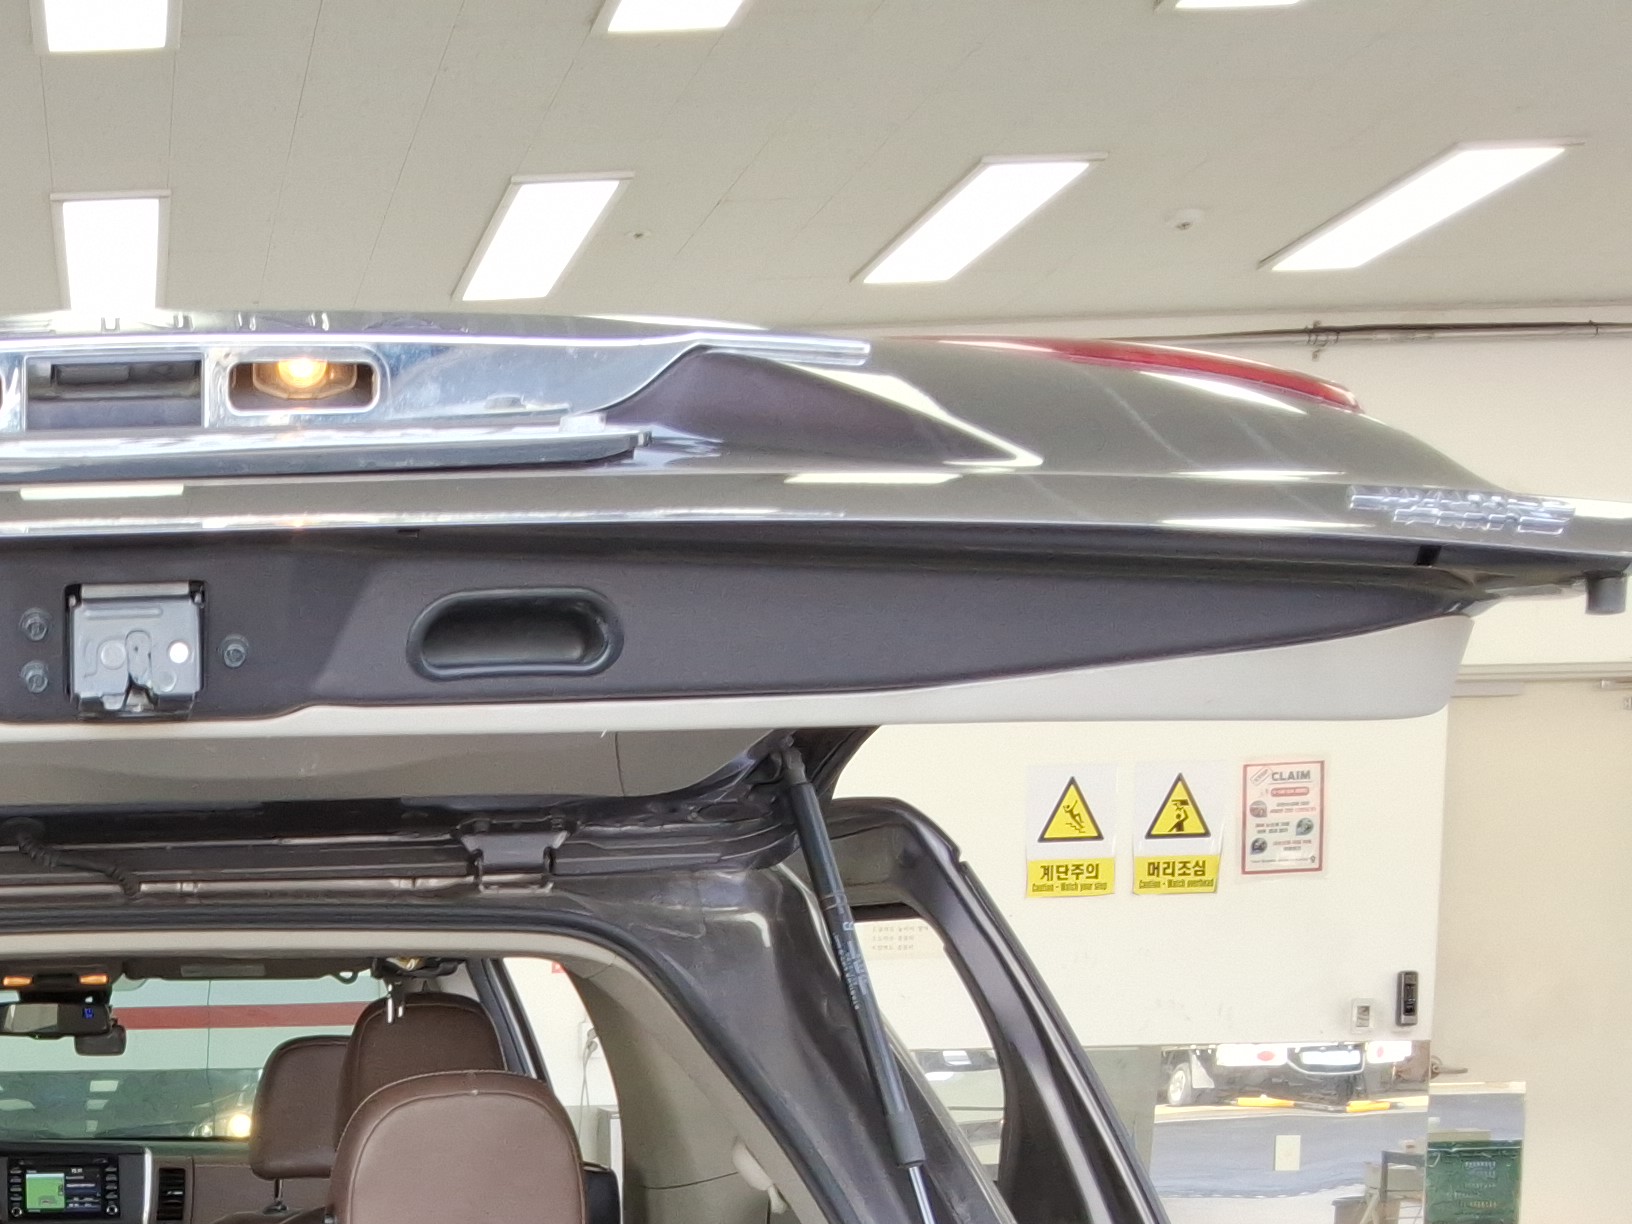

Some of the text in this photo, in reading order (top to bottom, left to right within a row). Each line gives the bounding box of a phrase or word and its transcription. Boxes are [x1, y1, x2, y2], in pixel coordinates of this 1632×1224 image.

[1271, 770, 1311, 782] CLAIM
[1040, 863, 1100, 881] 계단주의
[1147, 860, 1206, 877] 머리조심
